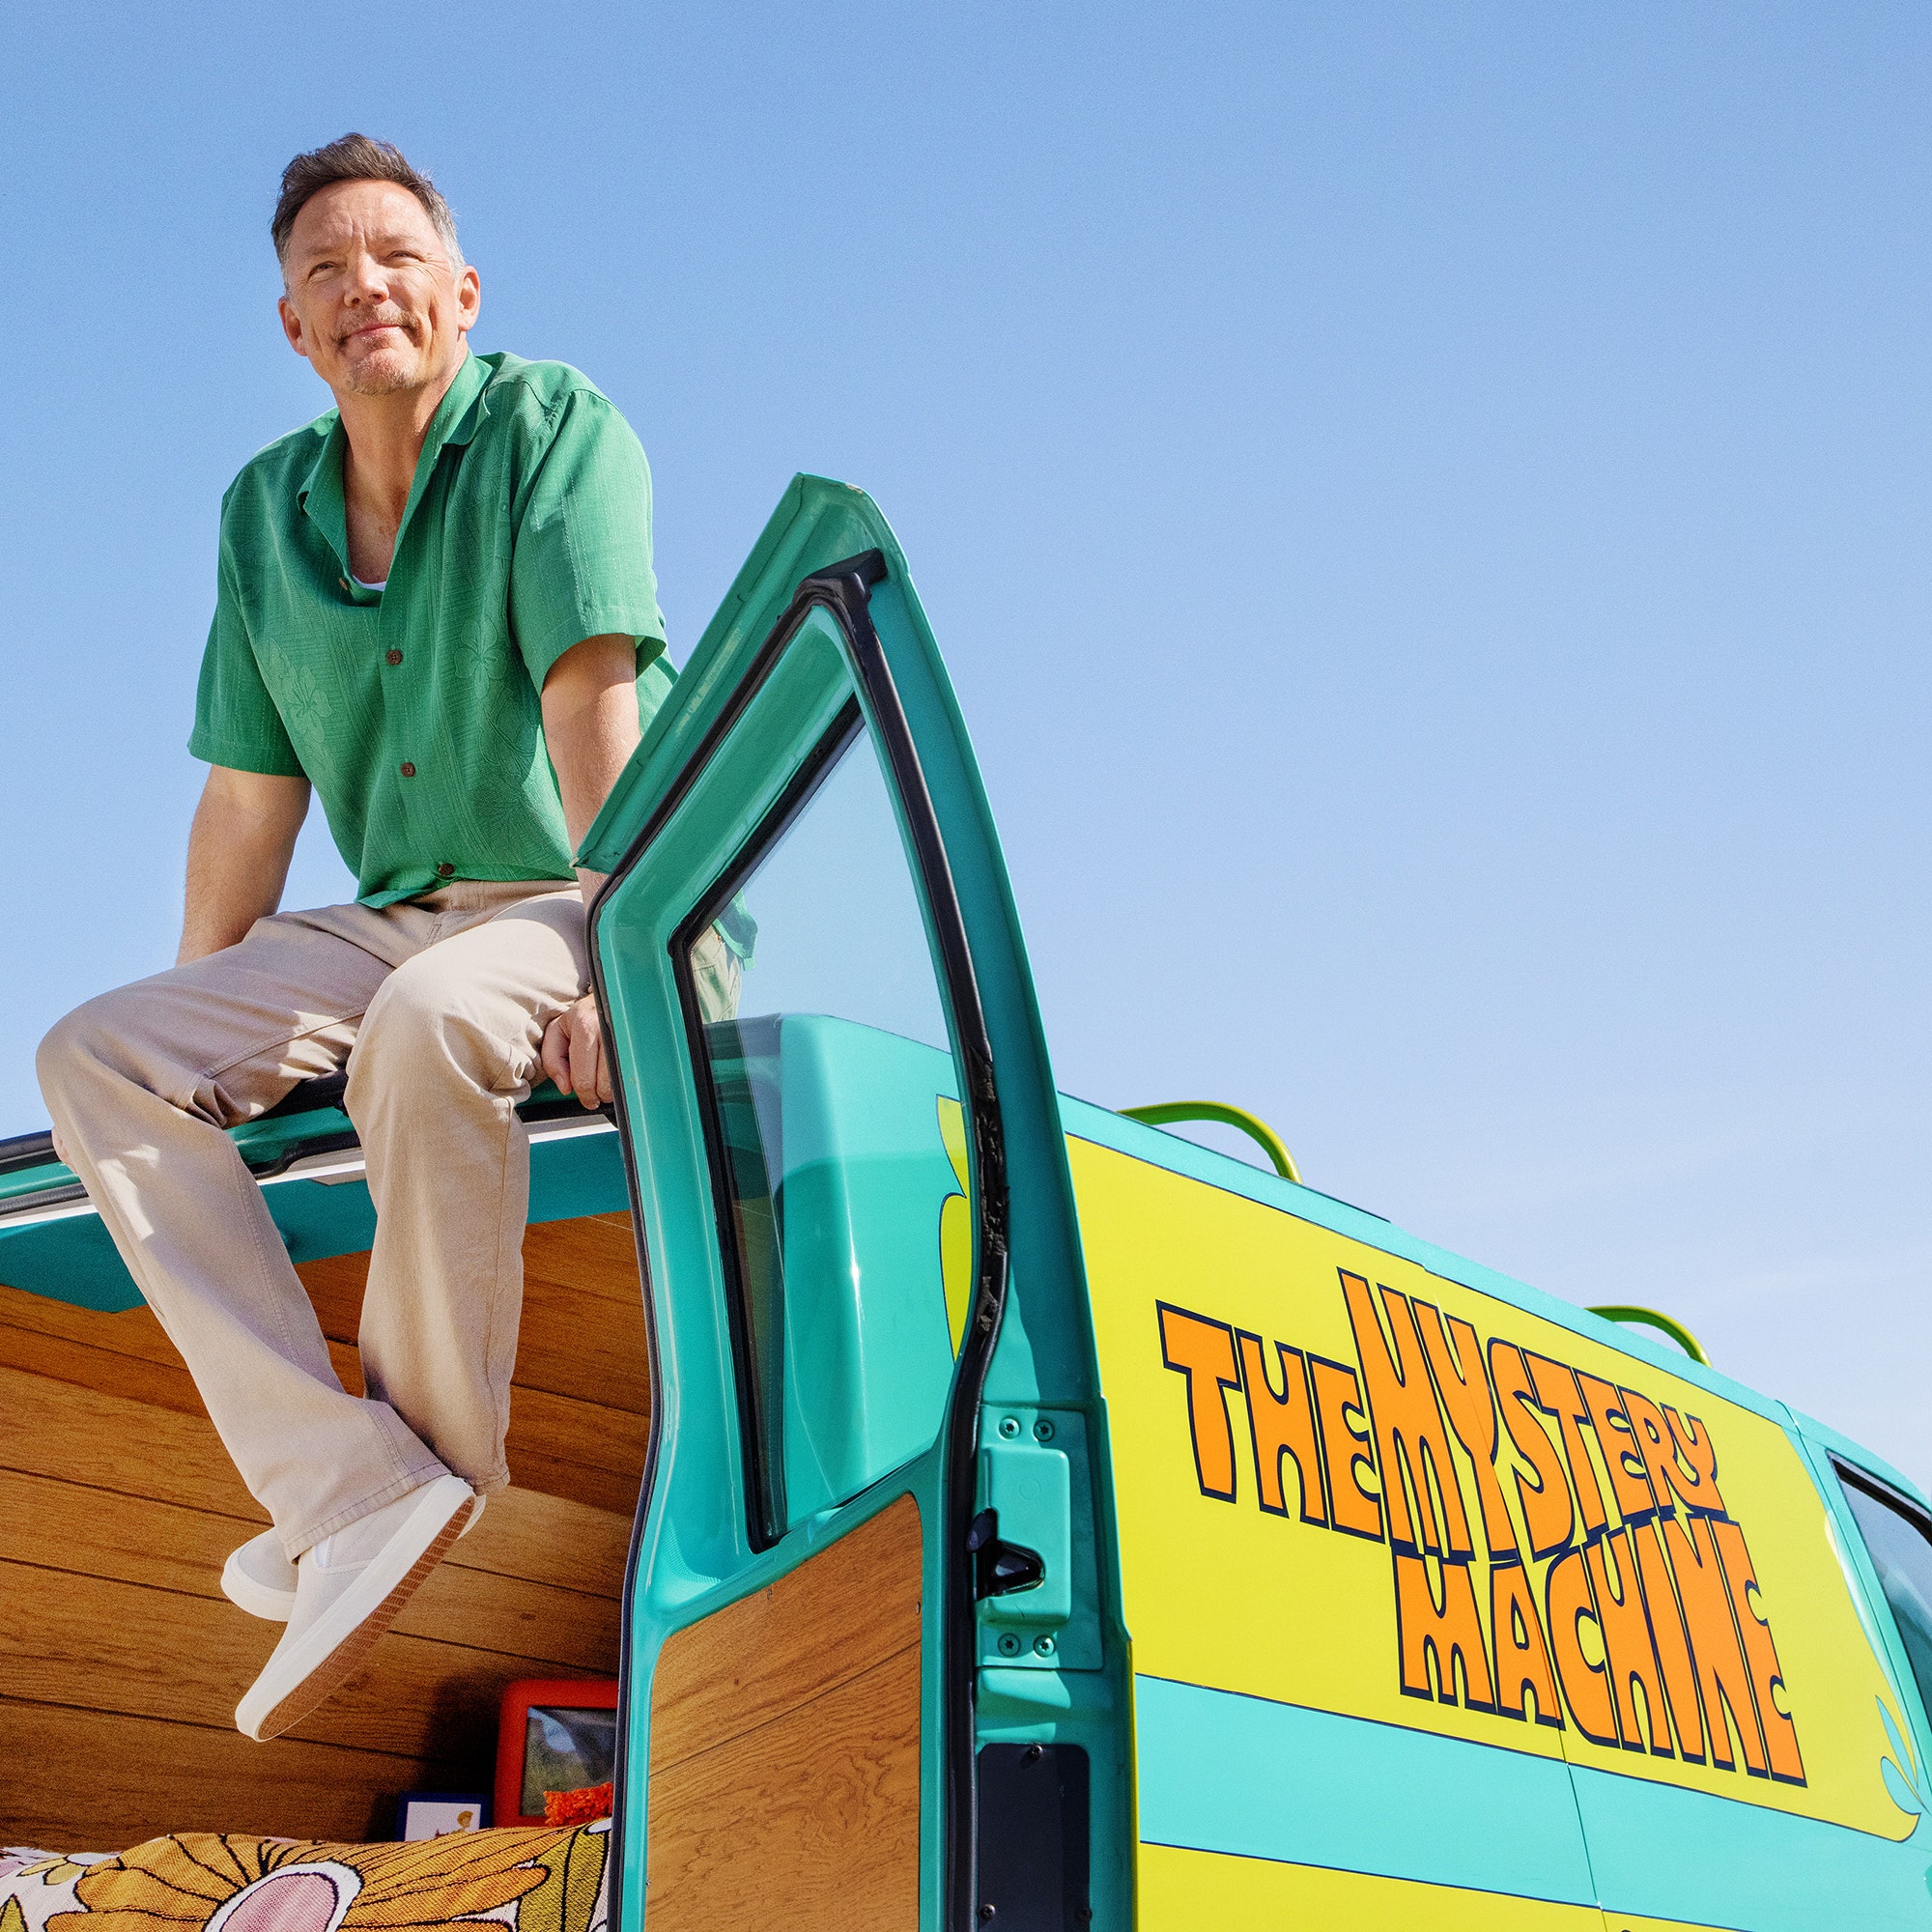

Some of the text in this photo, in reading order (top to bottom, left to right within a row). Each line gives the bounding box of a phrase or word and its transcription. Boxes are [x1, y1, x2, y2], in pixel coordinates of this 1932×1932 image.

[1155, 1266, 1727, 1562] THE MYSTERY
[1391, 1515, 1807, 1788] MACHINE
